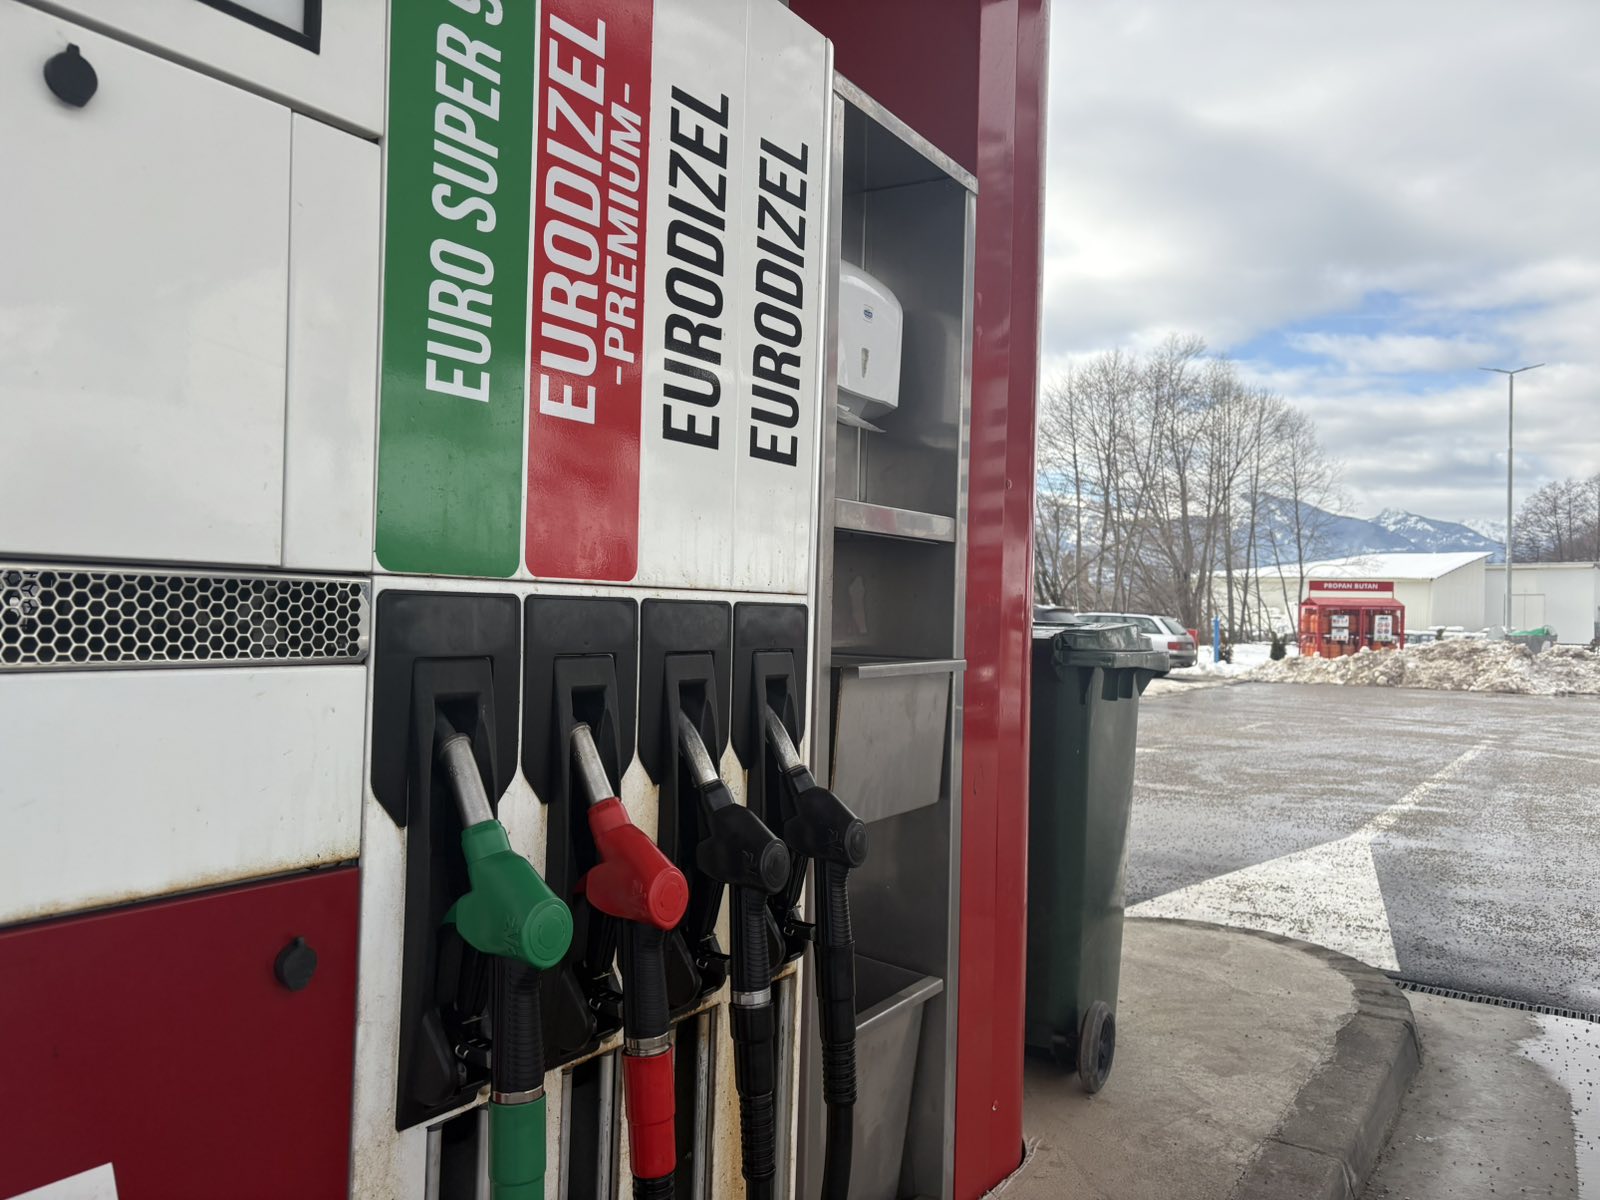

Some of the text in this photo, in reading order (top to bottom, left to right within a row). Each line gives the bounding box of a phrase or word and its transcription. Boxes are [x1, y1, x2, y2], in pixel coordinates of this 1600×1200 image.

[432, 23, 502, 233] SUPER
[539, 13, 606, 425] EURODIZEL
[425, 239, 494, 402] EURO
[662, 85, 729, 450] EURODIZEL
[749, 137, 809, 467] EURODIZEL
[1323, 582, 1378, 590] PROPAN BUTAN
